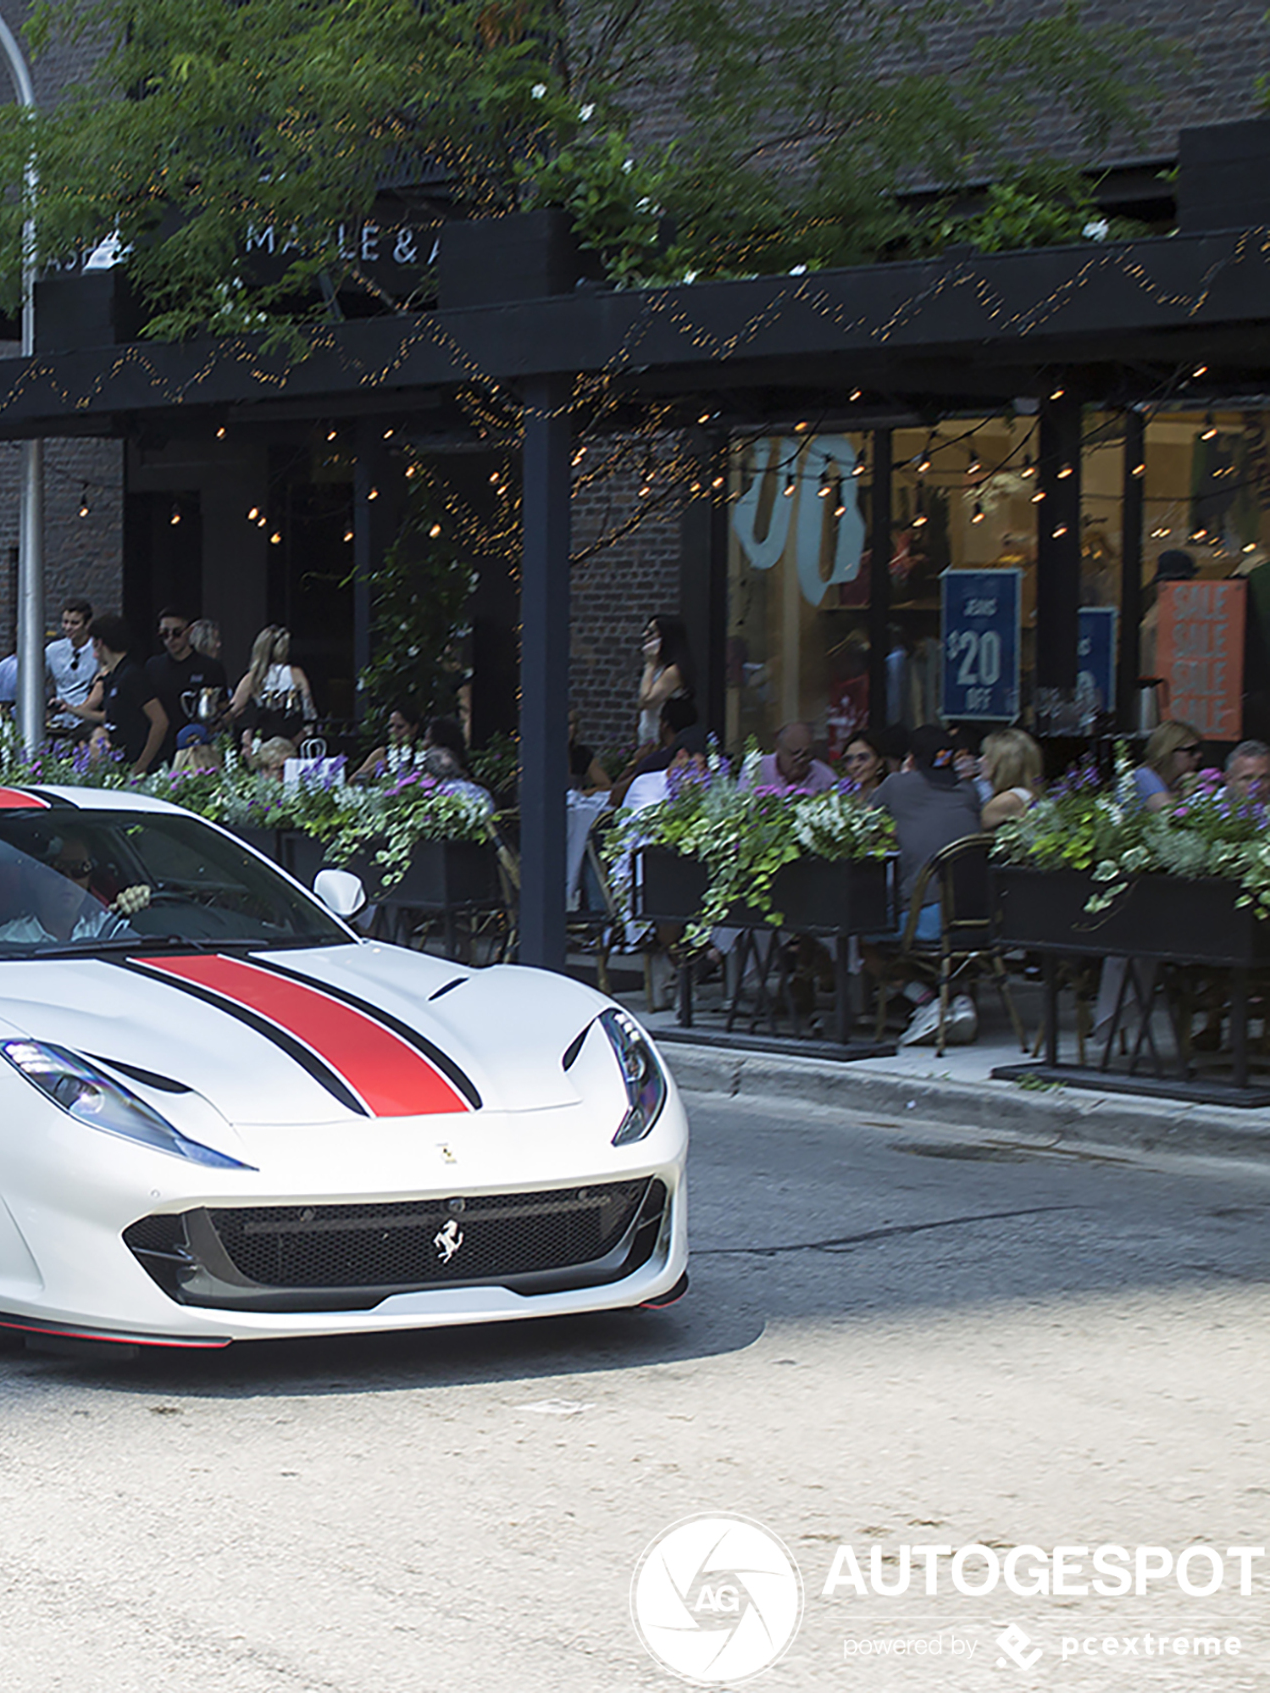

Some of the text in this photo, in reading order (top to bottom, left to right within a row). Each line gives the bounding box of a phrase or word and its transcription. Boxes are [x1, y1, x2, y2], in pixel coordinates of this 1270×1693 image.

[246, 222, 380, 262] MALE
[392, 228, 418, 264] &
[1173, 584, 1229, 621] SALE
[946, 630, 1001, 687] $20
[1172, 622, 1228, 658] SALE
[1171, 660, 1227, 696] SALE
[965, 687, 994, 711] OFF
[1170, 697, 1227, 734] SALE
